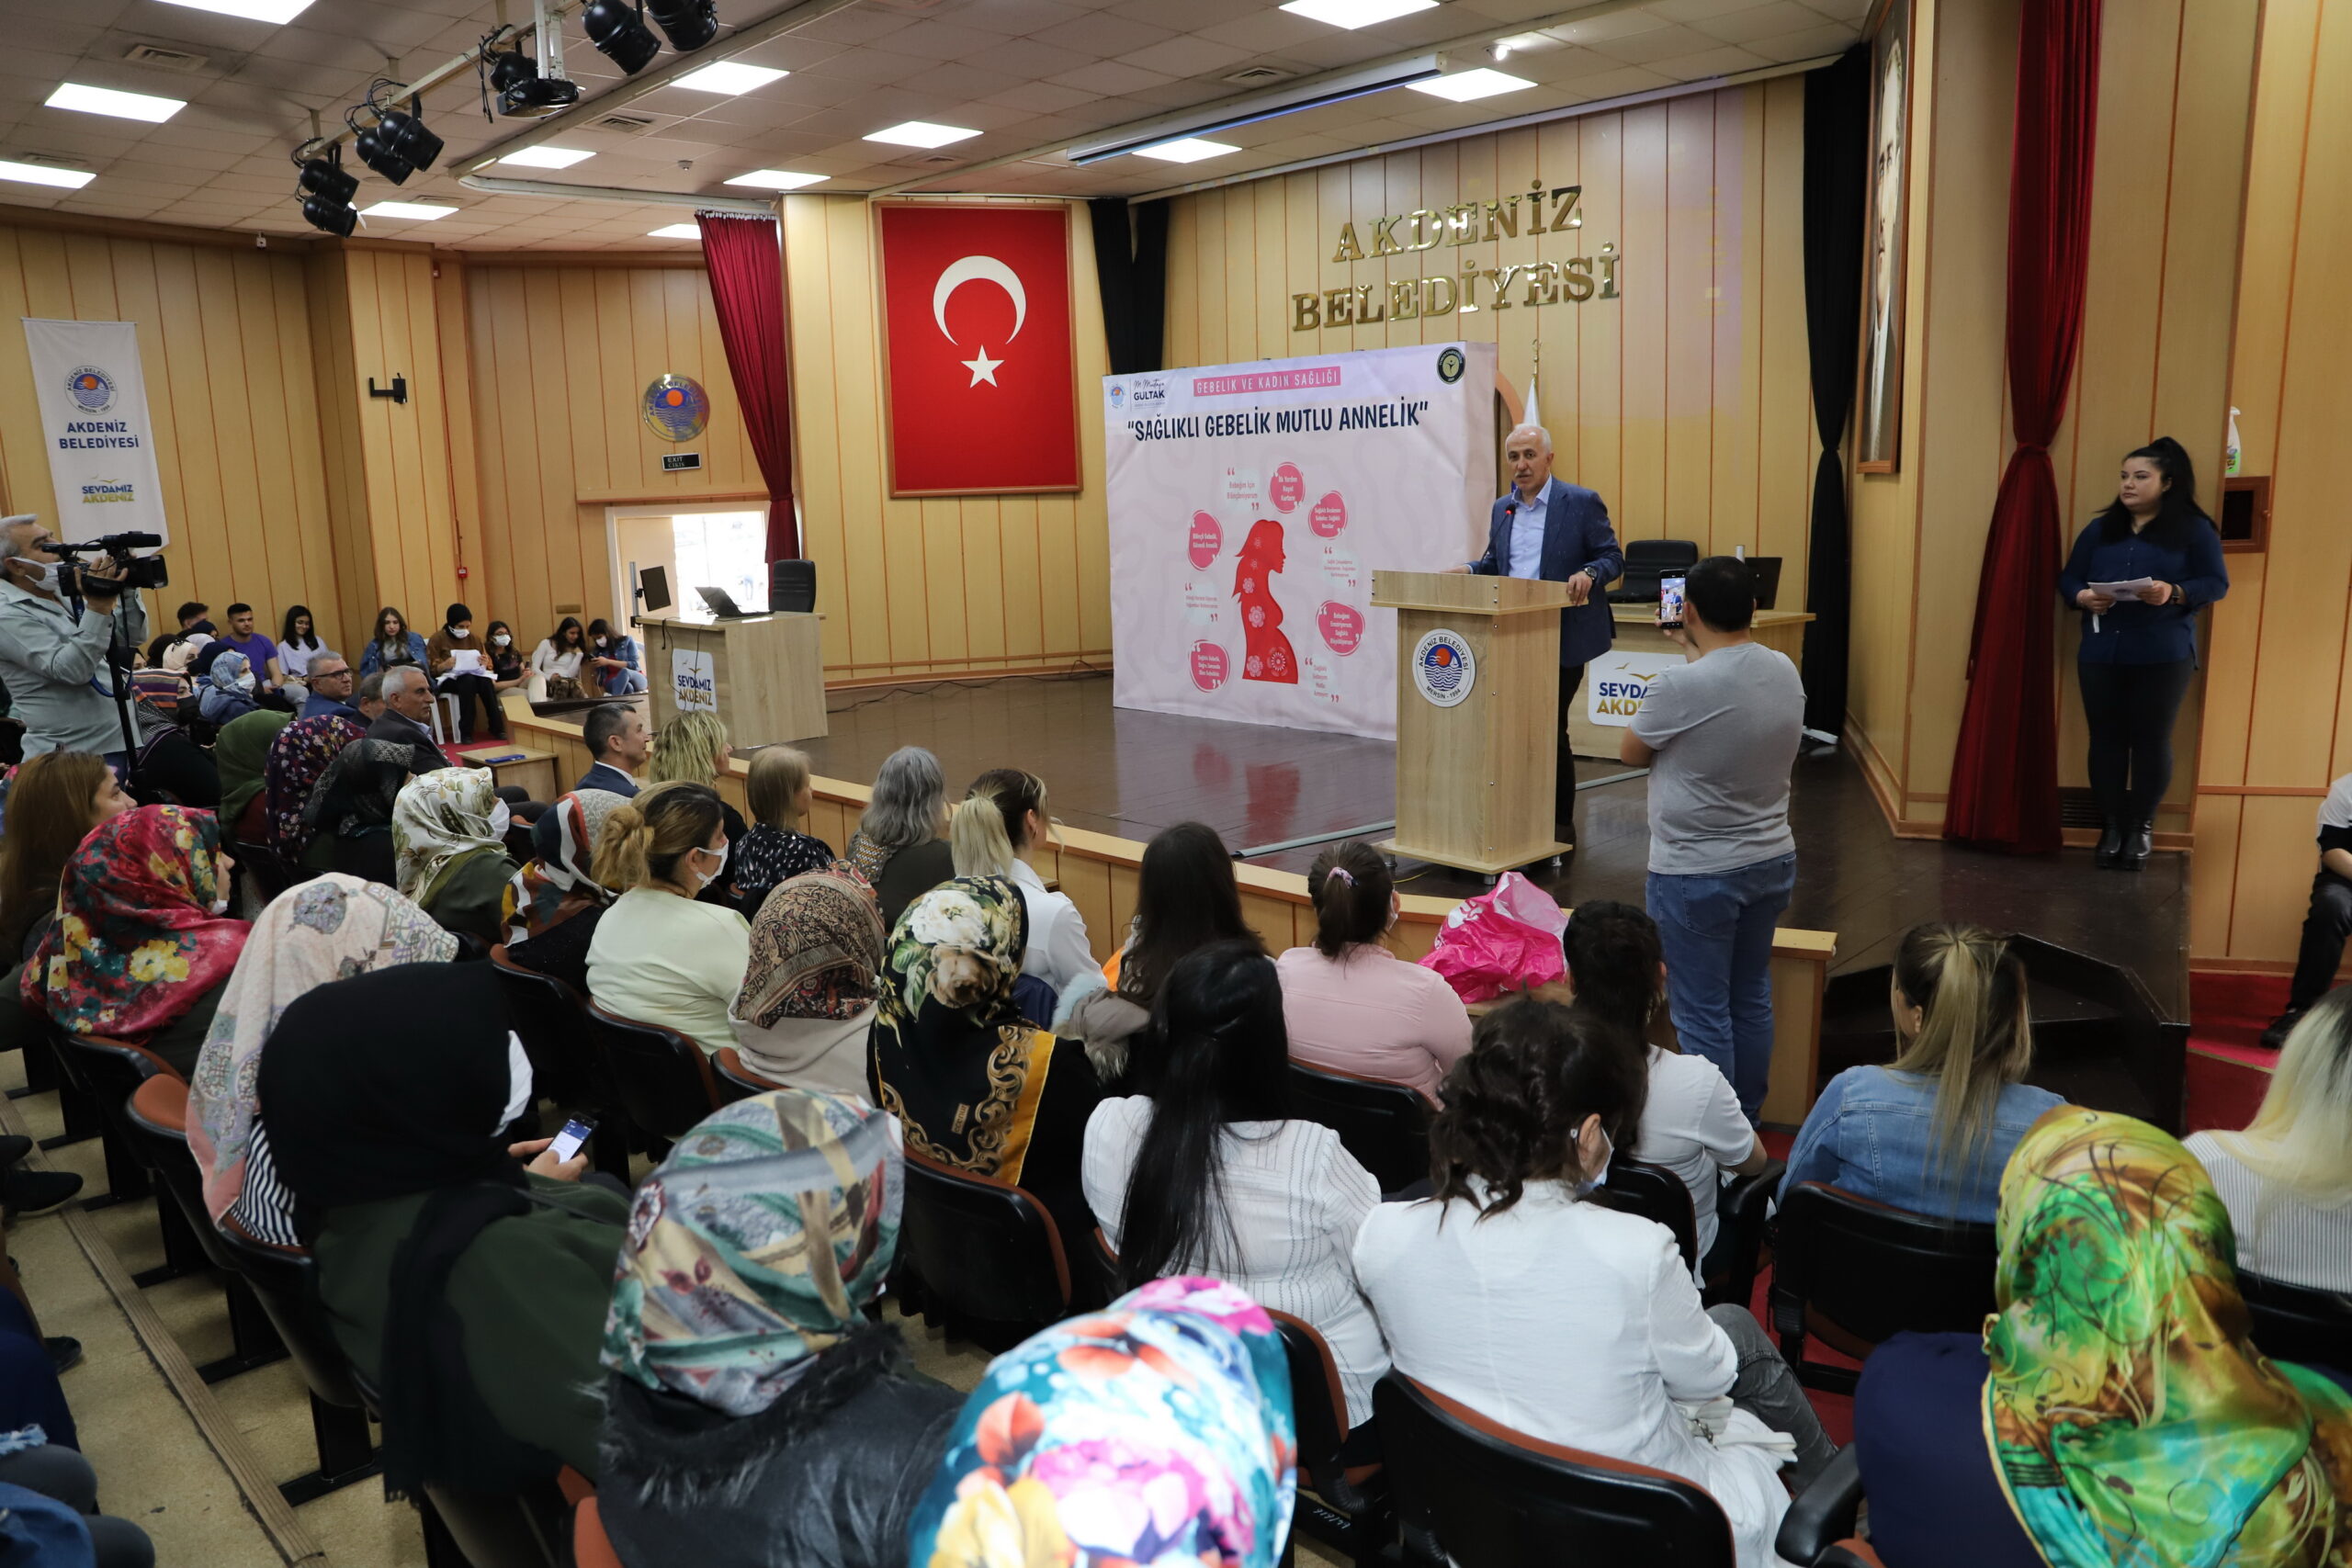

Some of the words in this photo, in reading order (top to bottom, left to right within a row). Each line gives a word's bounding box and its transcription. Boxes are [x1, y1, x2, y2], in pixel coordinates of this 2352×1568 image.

[1332, 179, 1582, 263] AKDENİZ
[1292, 242, 1620, 332] BELEDİYESİ
[1196, 378, 1238, 395] GEBELİK
[1241, 378, 1254, 390] VE
[1258, 374, 1290, 389] KADIN
[1295, 368, 1338, 385] SAĞLIĞI
[67, 419, 128, 433] AKDENİZ
[1204, 406, 1271, 437] GEBELİK
[1276, 406, 1333, 433] MUTLU
[59, 434, 140, 449] BELEDİYESİ
[83, 484, 133, 494] SEVDAMIZ
[83, 492, 134, 503] AKDENİZ
[1419, 637, 1437, 667] AKDENİZ
[1439, 637, 1470, 671] BELEDİYESİ
[677, 674, 711, 691] SEVDAMIZ
[678, 688, 713, 705] AKDENİZ
[1426, 686, 1446, 699] MERSİN
[1450, 689, 1461, 698] 1994
